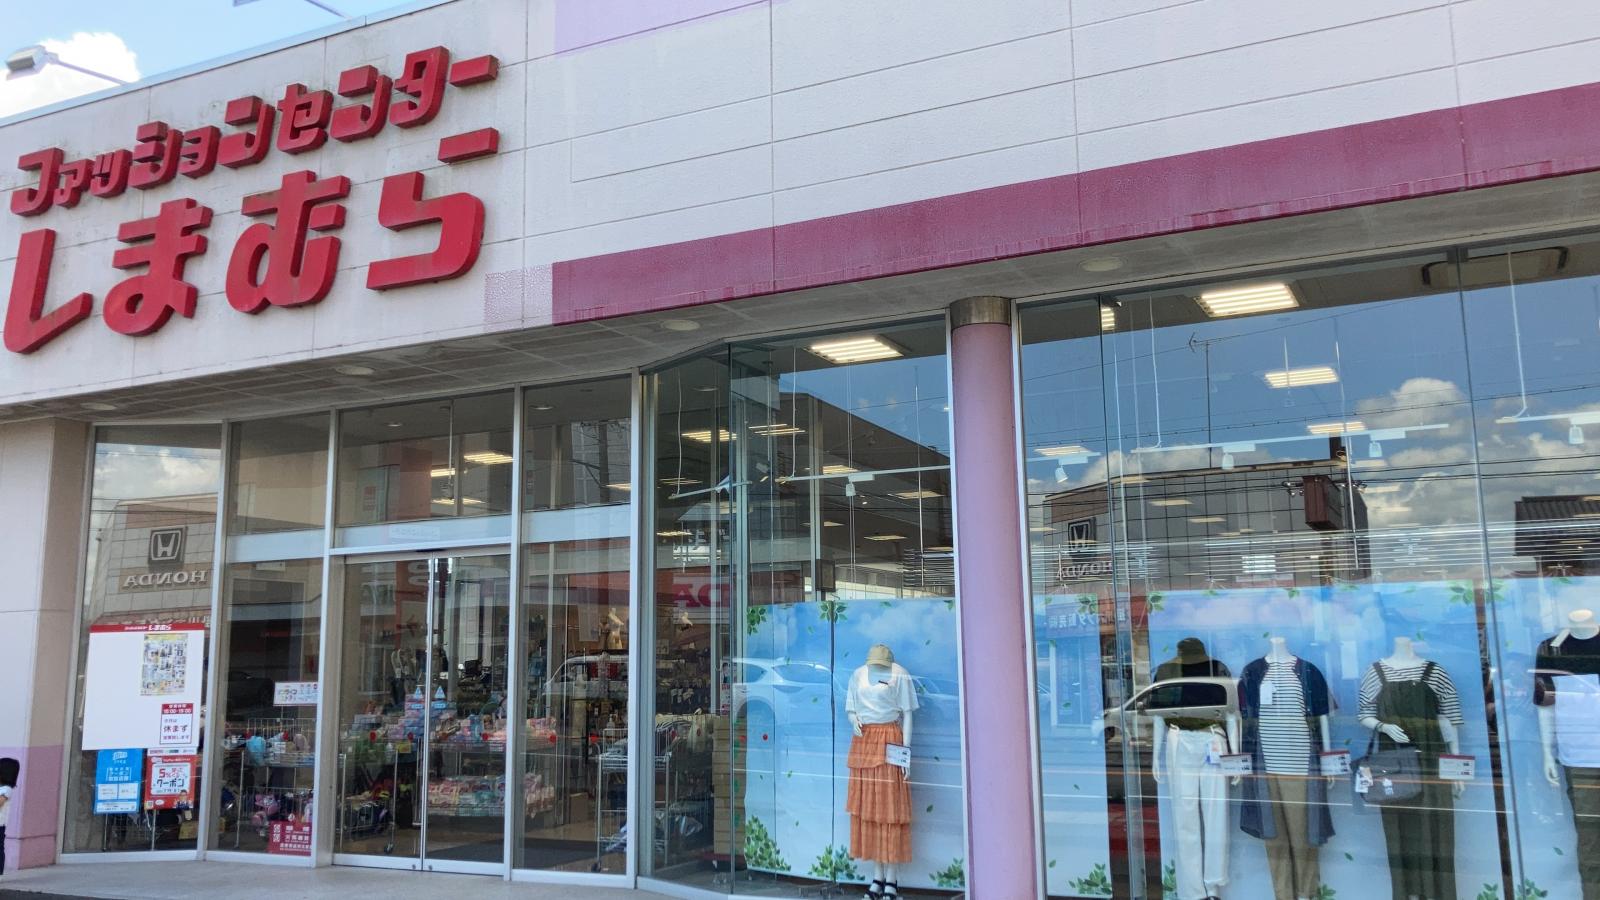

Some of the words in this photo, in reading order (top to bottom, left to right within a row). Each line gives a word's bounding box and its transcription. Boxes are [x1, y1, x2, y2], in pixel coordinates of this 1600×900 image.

[10, 45, 499, 217] ファッションセンター
[3, 127, 499, 354] しまむら
[156, 778, 185, 788] クーポン
